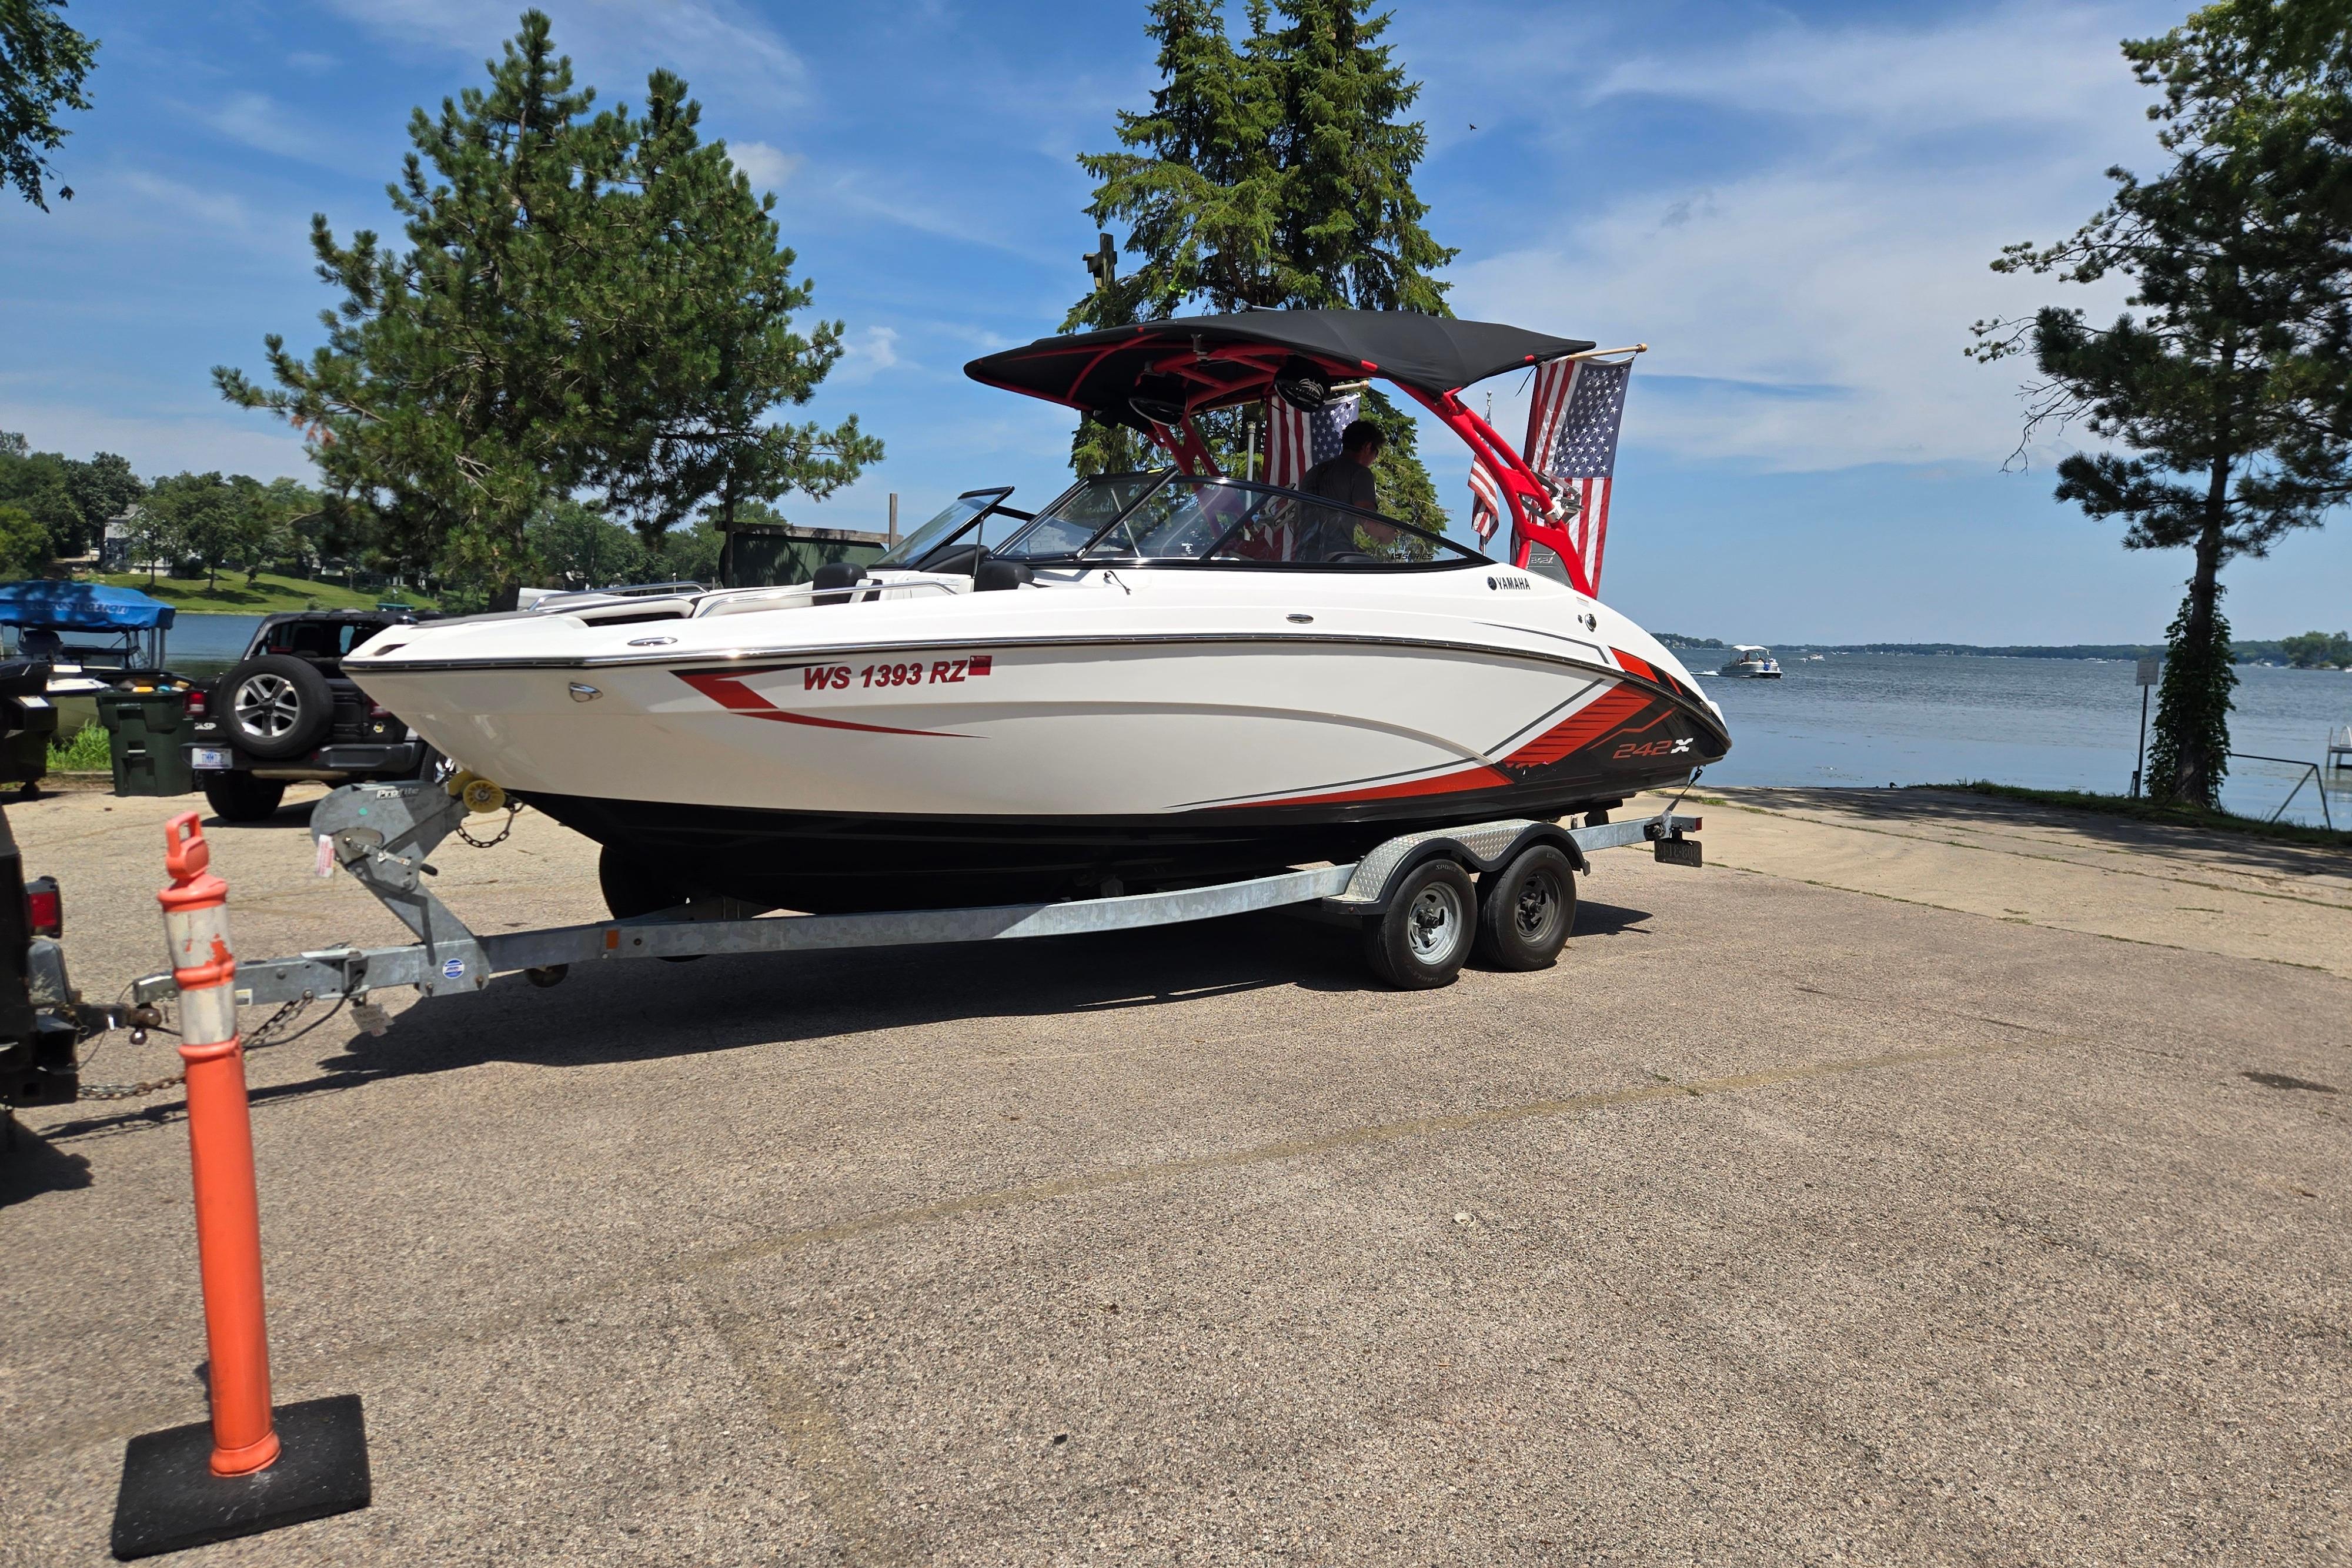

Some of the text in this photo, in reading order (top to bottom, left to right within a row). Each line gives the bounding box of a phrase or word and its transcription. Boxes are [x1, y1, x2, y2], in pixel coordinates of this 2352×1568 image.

[1496, 577, 1531, 590] YAMAHA
[804, 660, 968, 690] WS 1393 RZ
[1613, 738, 1693, 759] 242X
